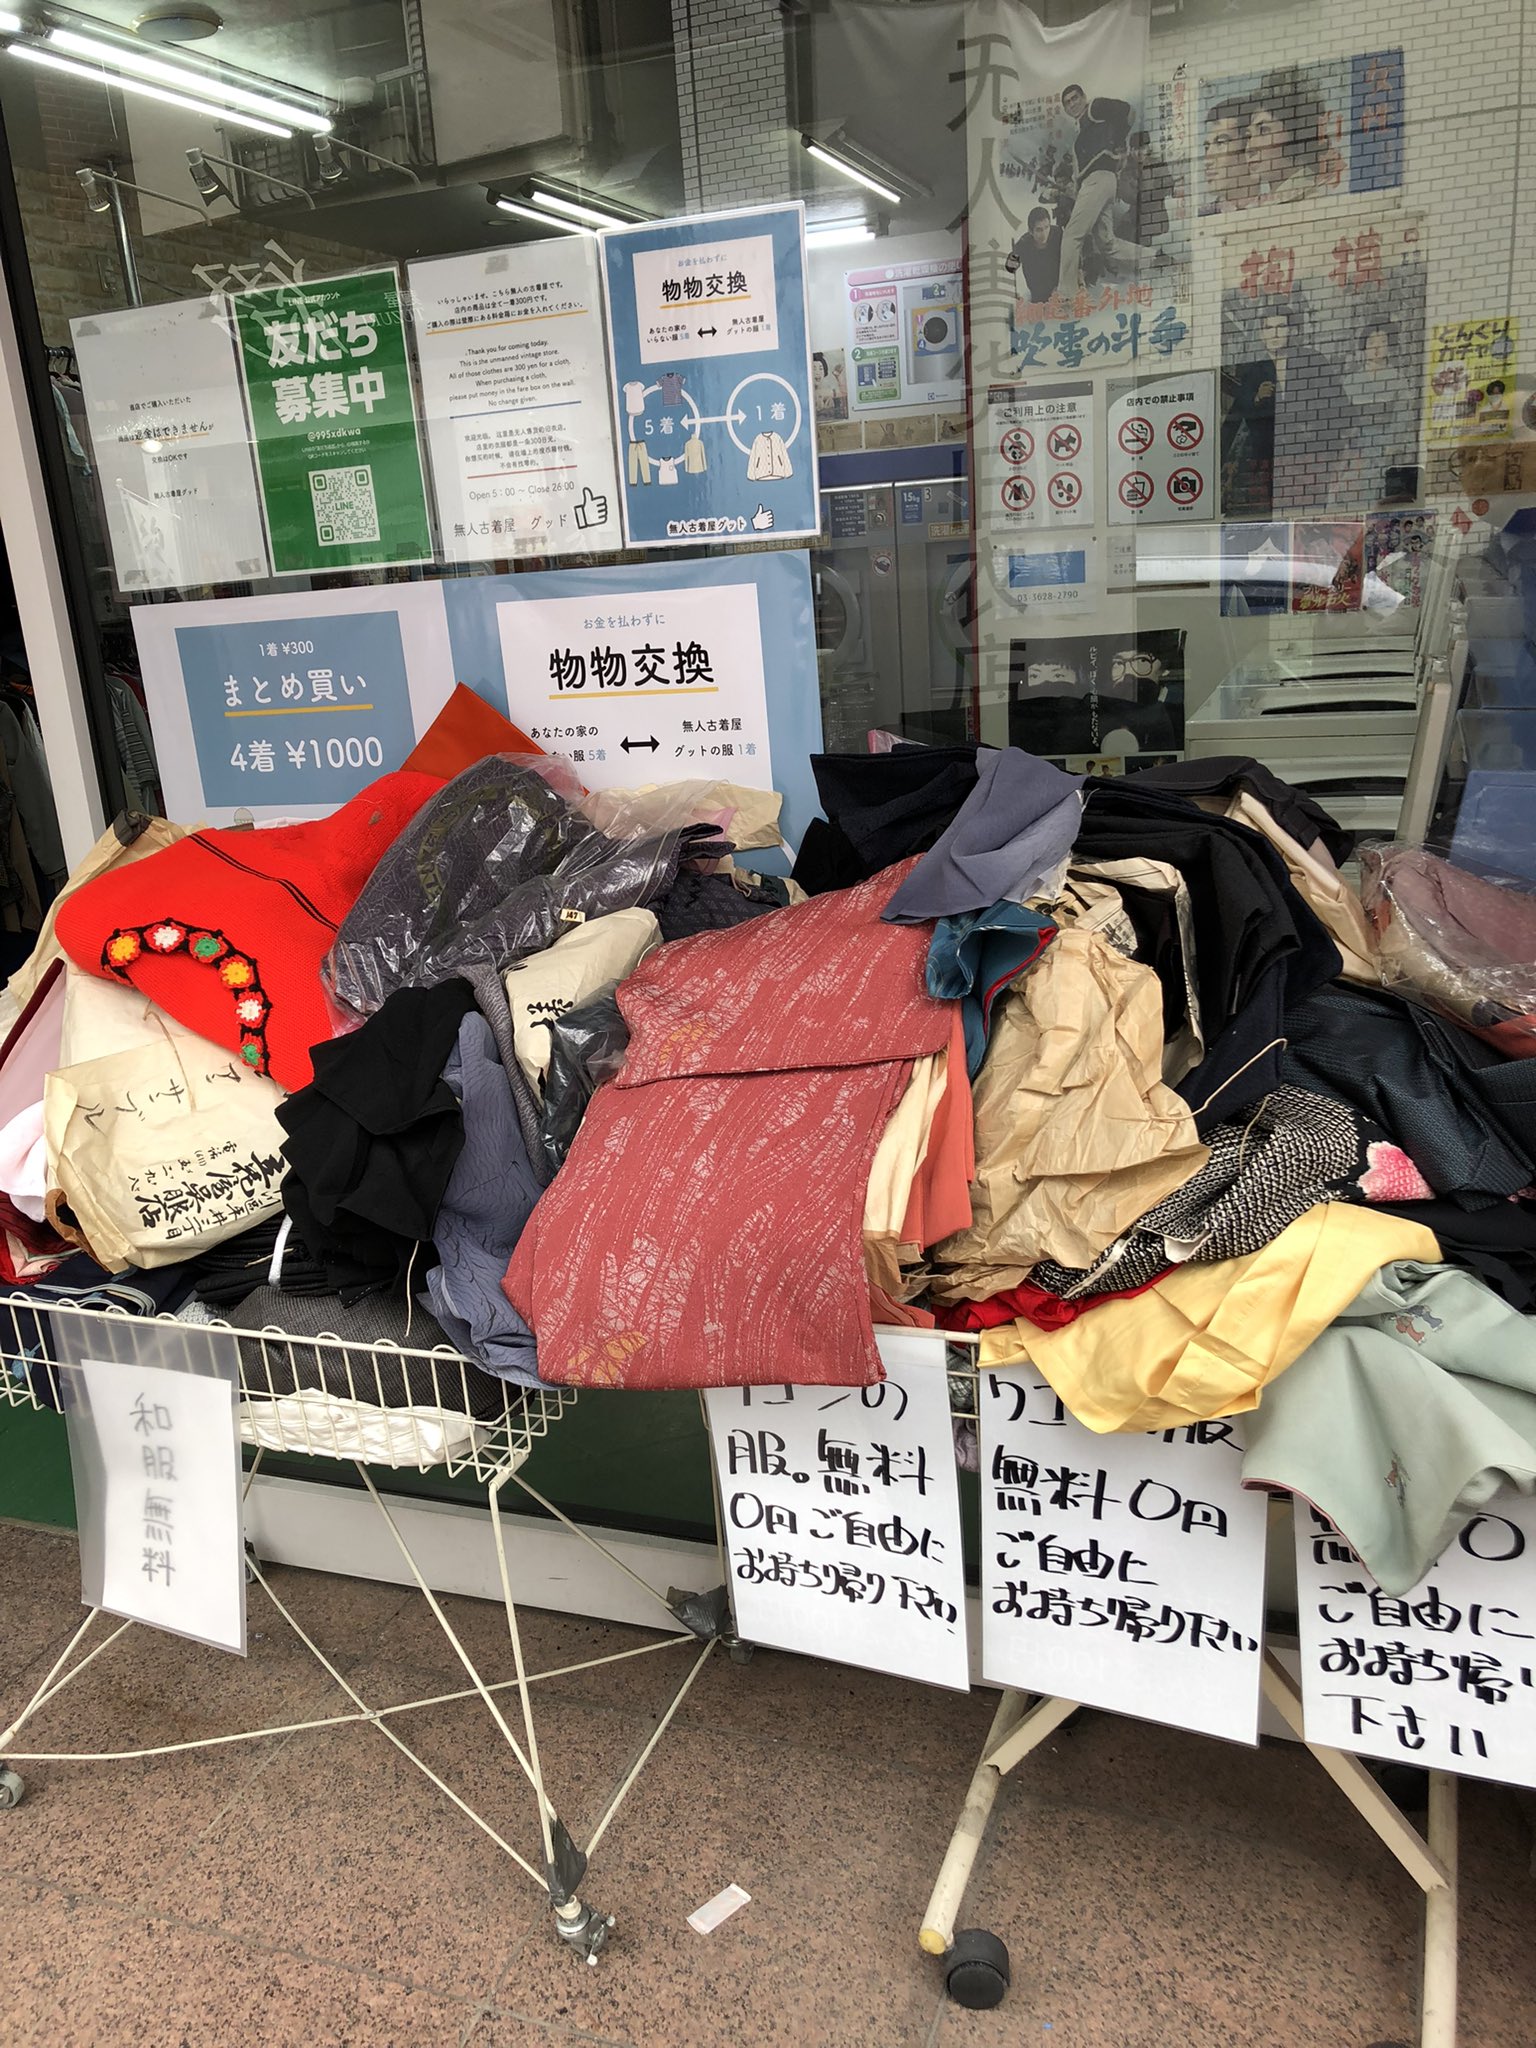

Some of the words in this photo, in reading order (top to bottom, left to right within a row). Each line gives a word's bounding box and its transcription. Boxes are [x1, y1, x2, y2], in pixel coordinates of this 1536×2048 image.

[678, 254, 728, 268] お金を払わずに
[661, 270, 748, 302] 物物交換
[649, 324, 687, 335] あなたの家の
[264, 310, 379, 369] 友だち
[646, 333, 679, 344] いらない服
[468, 347, 485, 356] Thank
[486, 346, 497, 355] you
[498, 344, 507, 352] for
[508, 342, 529, 352] coming
[460, 359, 472, 368] This
[473, 359, 478, 367] is
[490, 354, 519, 364] unmanned
[520, 351, 542, 361] vintage
[458, 371, 464, 379] of
[465, 369, 481, 378] those
[482, 366, 503, 377] clothes
[515, 363, 526, 372] 300
[527, 363, 538, 373] yen
[539, 361, 548, 369] for
[475, 379, 492, 388] When
[493, 376, 524, 387] purchasing
[271, 366, 387, 425] 募集中
[449, 392, 467, 402] please
[468, 391, 478, 400] put
[480, 389, 498, 399] money
[506, 386, 516, 394] the
[517, 384, 529, 392] fare
[530, 383, 541, 391] box
[551, 380, 561, 388] the
[488, 399, 497, 407] No
[498, 396, 519, 406] change
[1126, 393, 1195, 407] 店内での禁止事項
[1003, 402, 1077, 418] ご利用上の注意
[307, 427, 361, 442] @995xdkwa
[469, 489, 491, 501] Open
[527, 483, 550, 495] Close
[334, 501, 354, 511] LINE
[453, 518, 516, 537] 無人古着屋
[531, 513, 567, 530] グッド
[583, 613, 666, 630] お金を払わずに
[259, 642, 279, 657] 1着
[282, 640, 314, 655] ¥300
[549, 641, 715, 690] 物物交換
[224, 668, 367, 707] まとめ買い
[531, 725, 598, 739] あなたの家の
[682, 717, 742, 733] 無人古着屋
[230, 740, 276, 773] 4着
[285, 736, 383, 770] ¥1000
[588, 749, 607, 761] 5着
[737, 742, 757, 756] 1着
[130, 1393, 178, 1587] 和服無料
[996, 1530, 1158, 1586] ご自由に
[993, 1581, 1259, 1652] お持ち帰り下さい
[1319, 1581, 1535, 1639] ご自由に
[1321, 1694, 1489, 1759] 下さい
